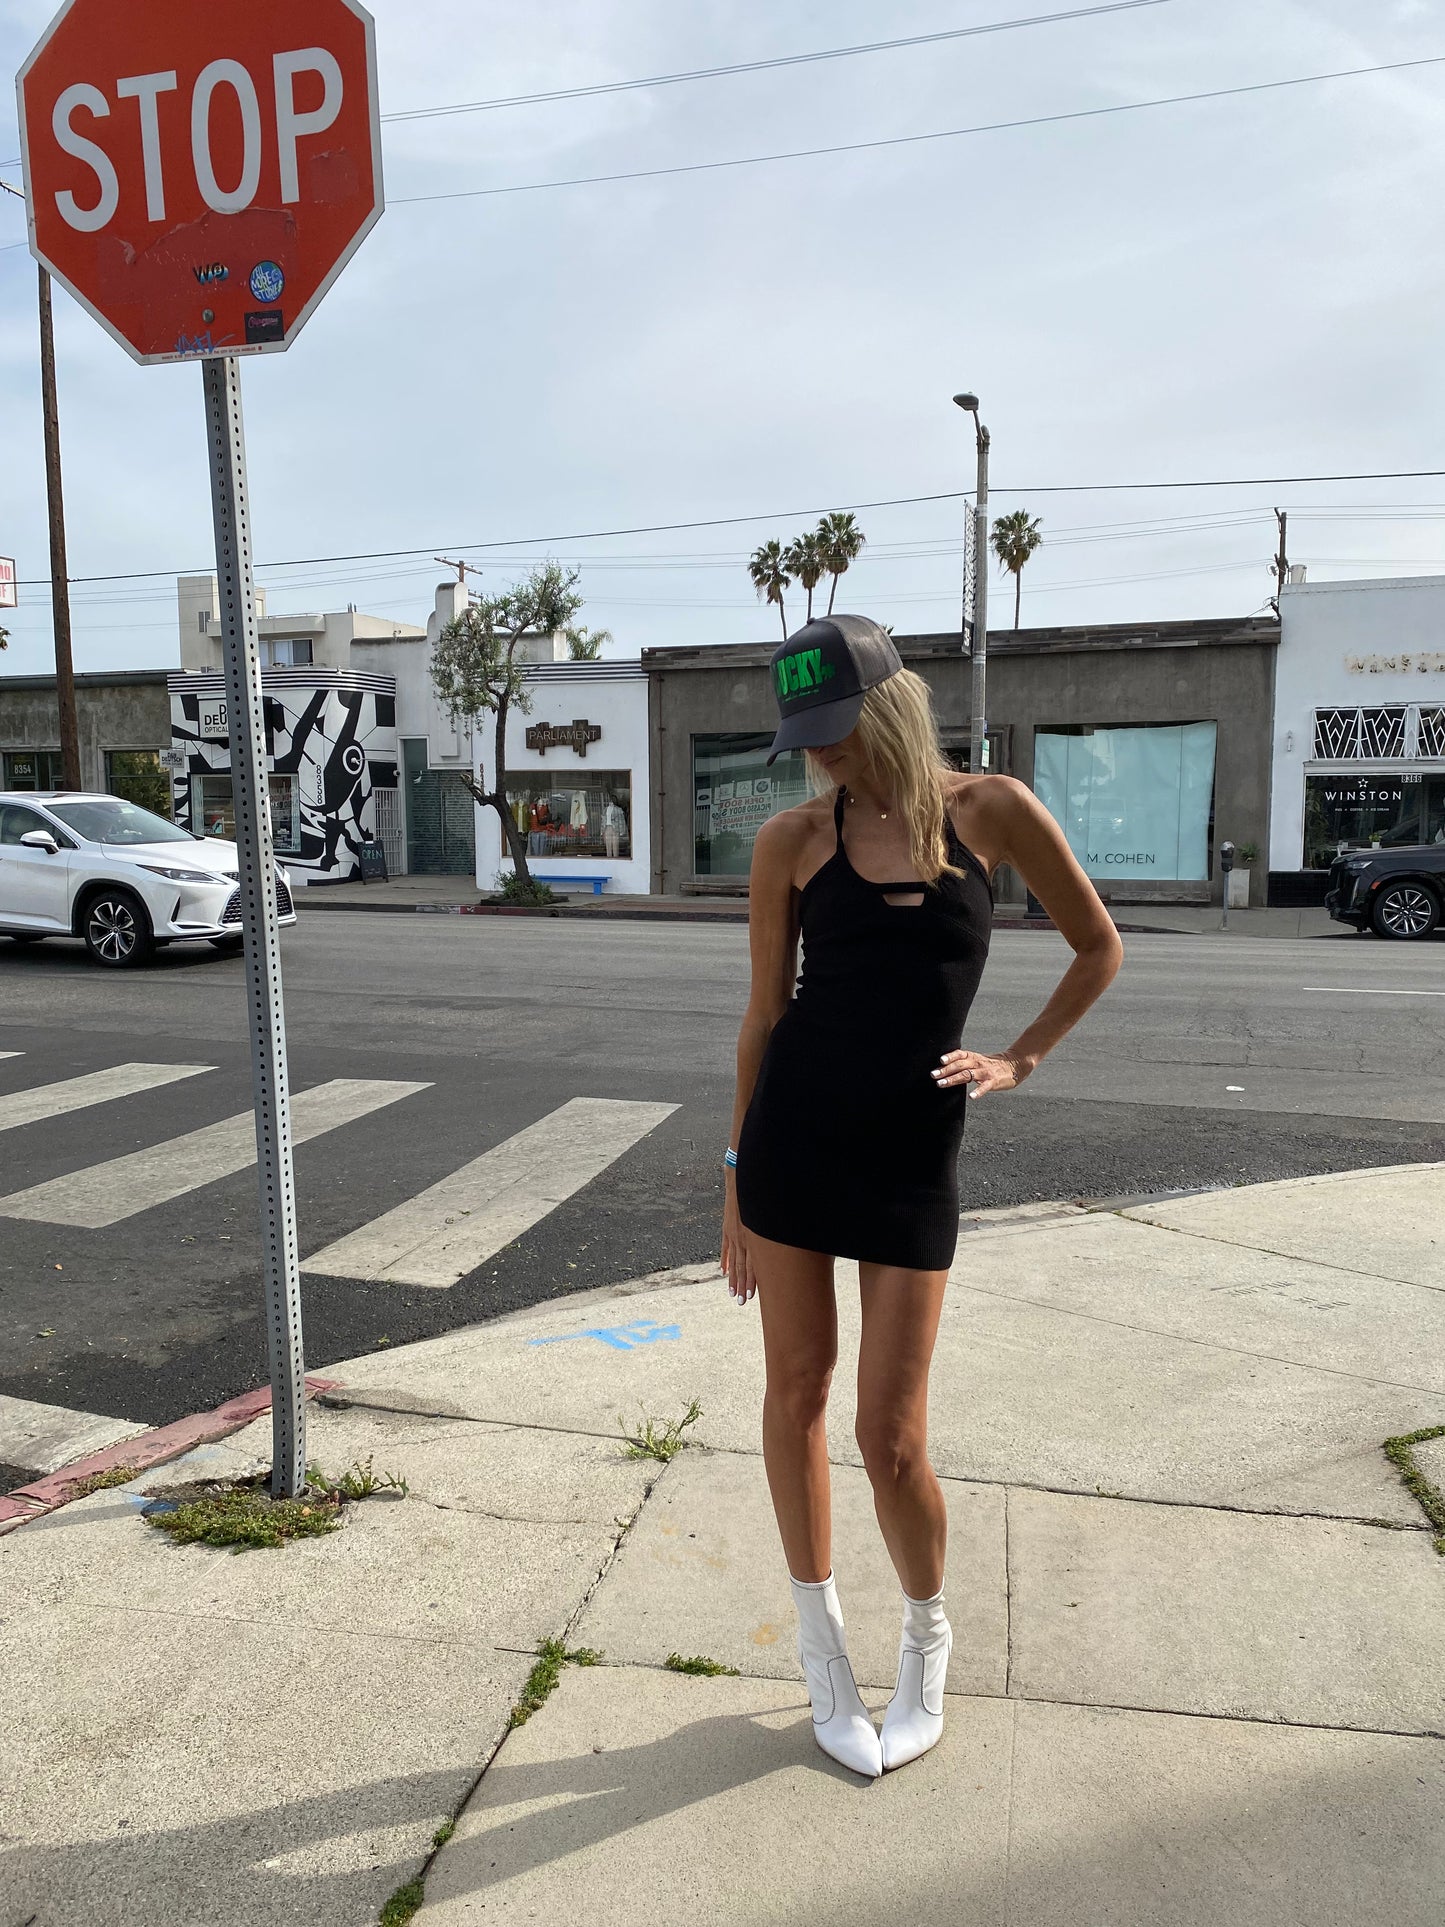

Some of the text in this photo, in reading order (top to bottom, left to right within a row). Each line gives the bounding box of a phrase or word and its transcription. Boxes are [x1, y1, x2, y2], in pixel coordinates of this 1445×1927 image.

[52, 47, 344, 232] STOP
[251, 271, 273, 291] MORE
[773, 648, 823, 697] UCKY
[204, 726, 229, 734] OPTICAL
[529, 729, 597, 741] PARLIAMENT
[14, 764, 32, 774] 8354
[1402, 775, 1421, 783] 8366
[1325, 791, 1402, 801] WINSTON
[545, 823, 589, 837] SALE
[361, 849, 383, 860] OPEN
[1087, 853, 1155, 864] M. COHEN
